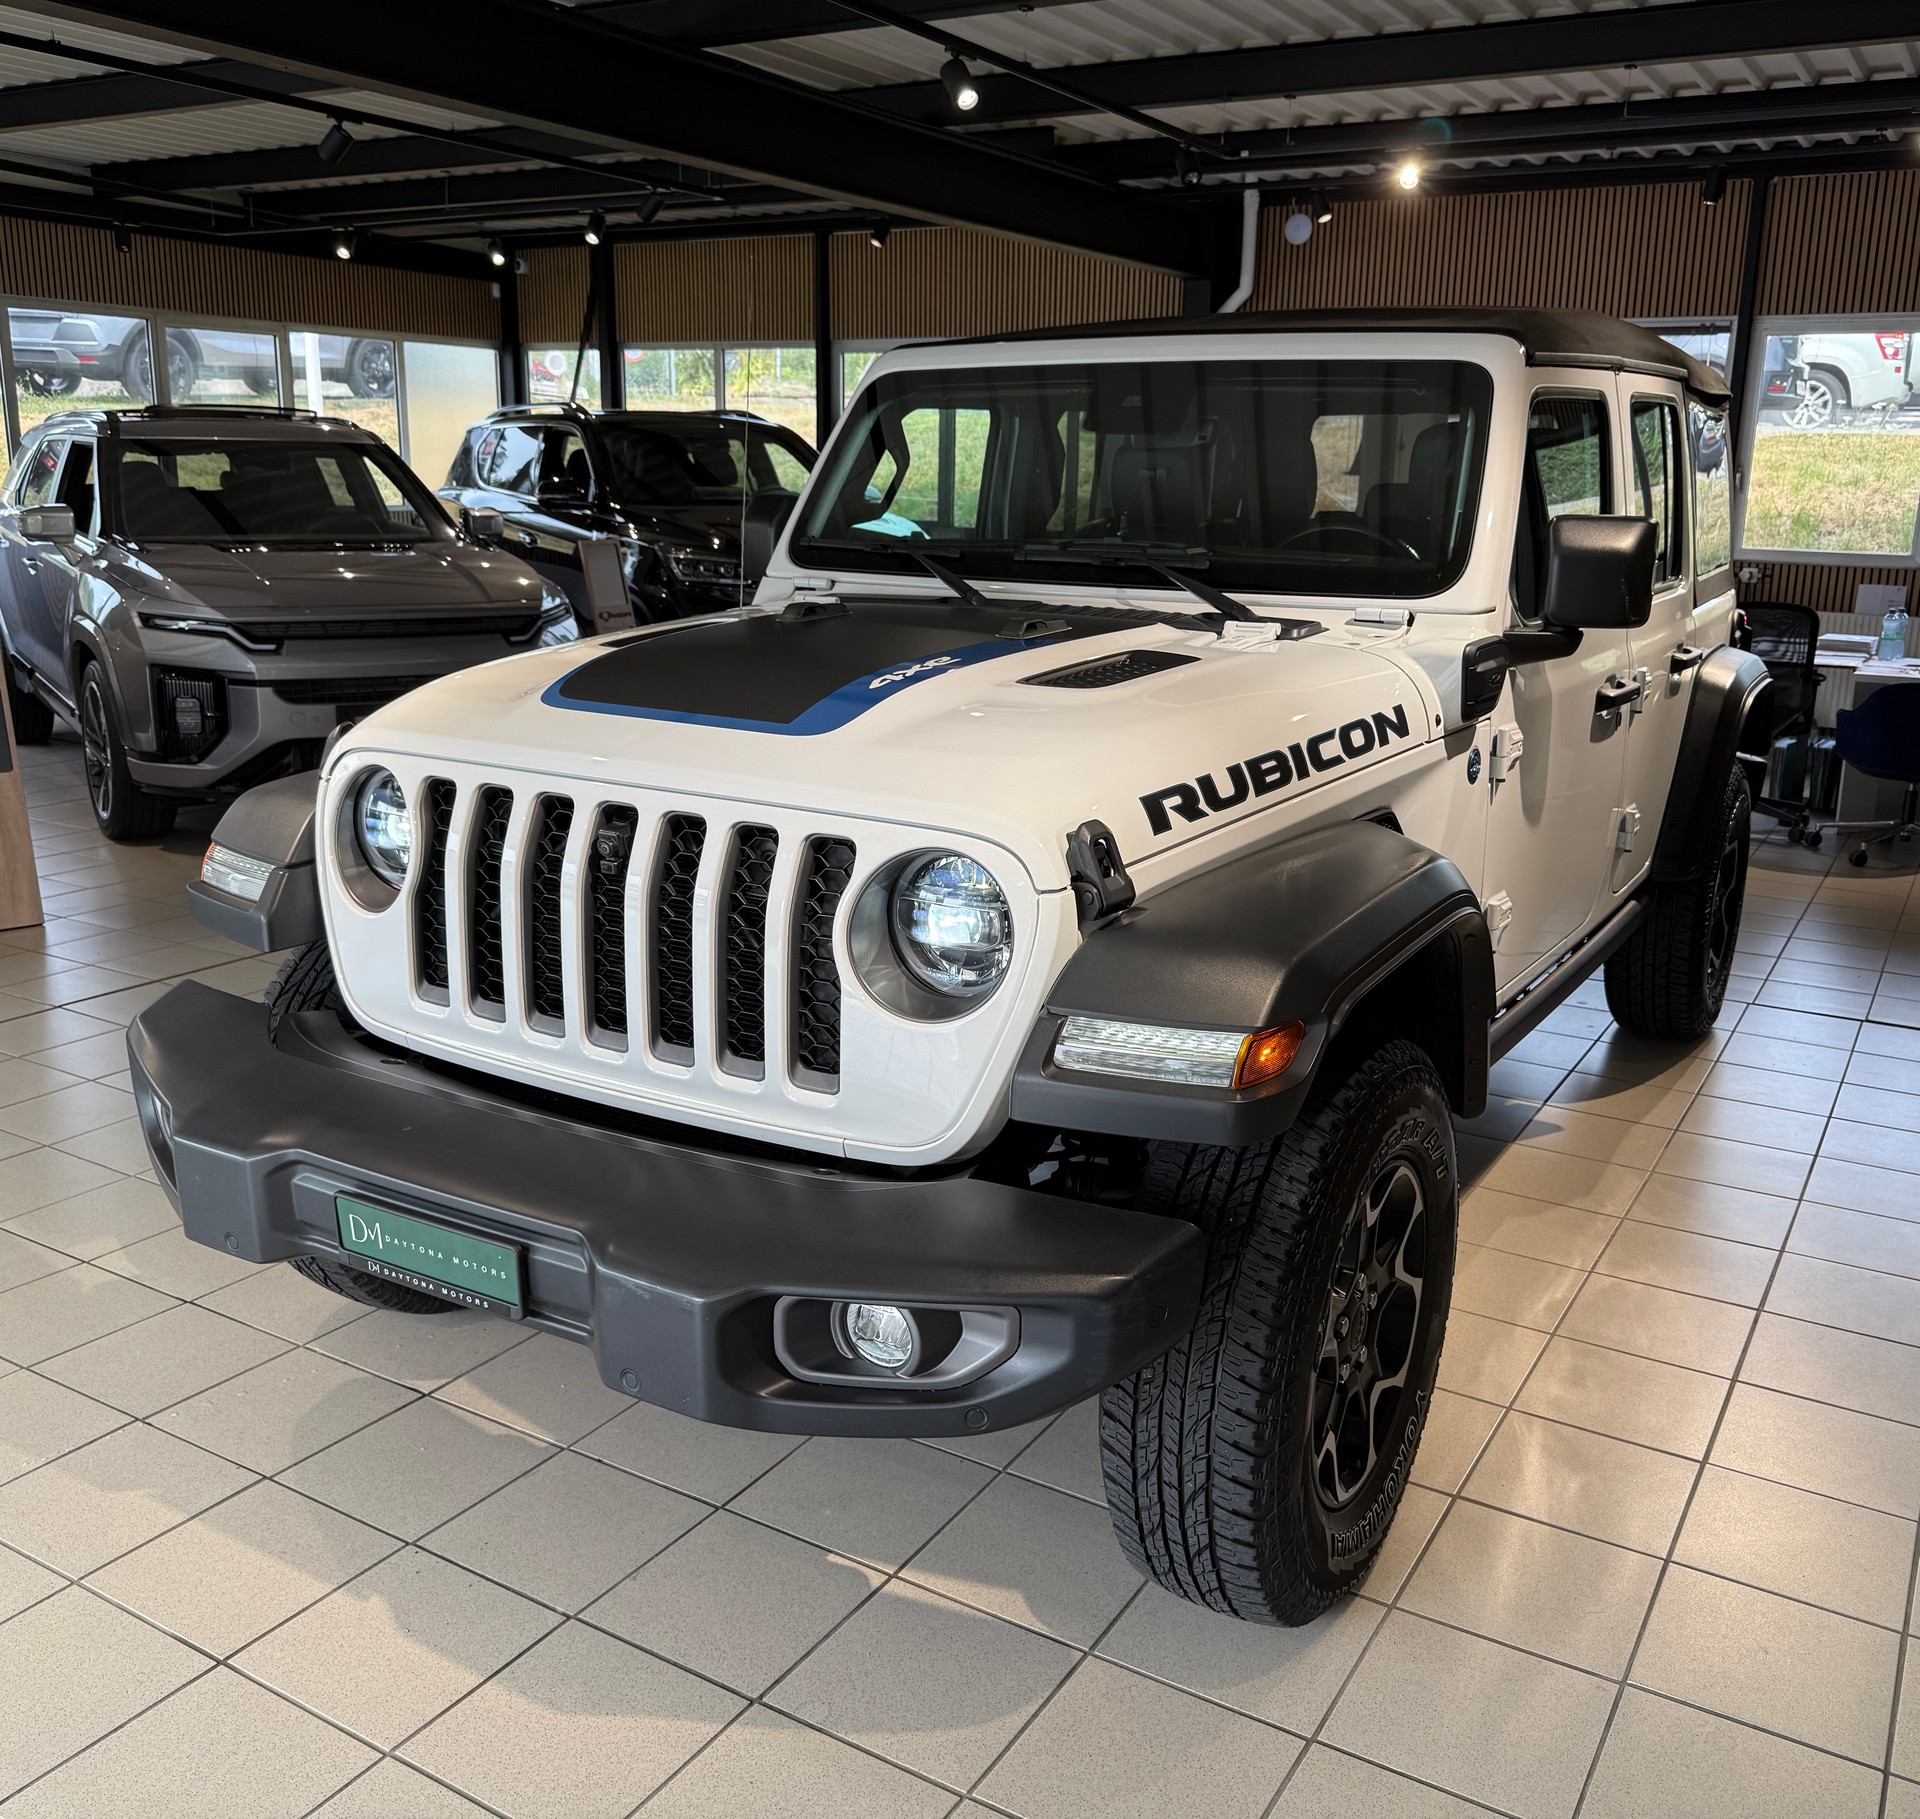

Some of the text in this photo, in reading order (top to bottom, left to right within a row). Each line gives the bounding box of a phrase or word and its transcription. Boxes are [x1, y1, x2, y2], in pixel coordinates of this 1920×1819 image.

[1138, 703, 1410, 836] RUBICON
[349, 1213, 507, 1280] DM DAYTONA MOTORS
[383, 1268, 435, 1291] DAYTONA
[441, 1287, 489, 1309] MOTORS
[1331, 1389, 1428, 1560] YOKOHAMA
